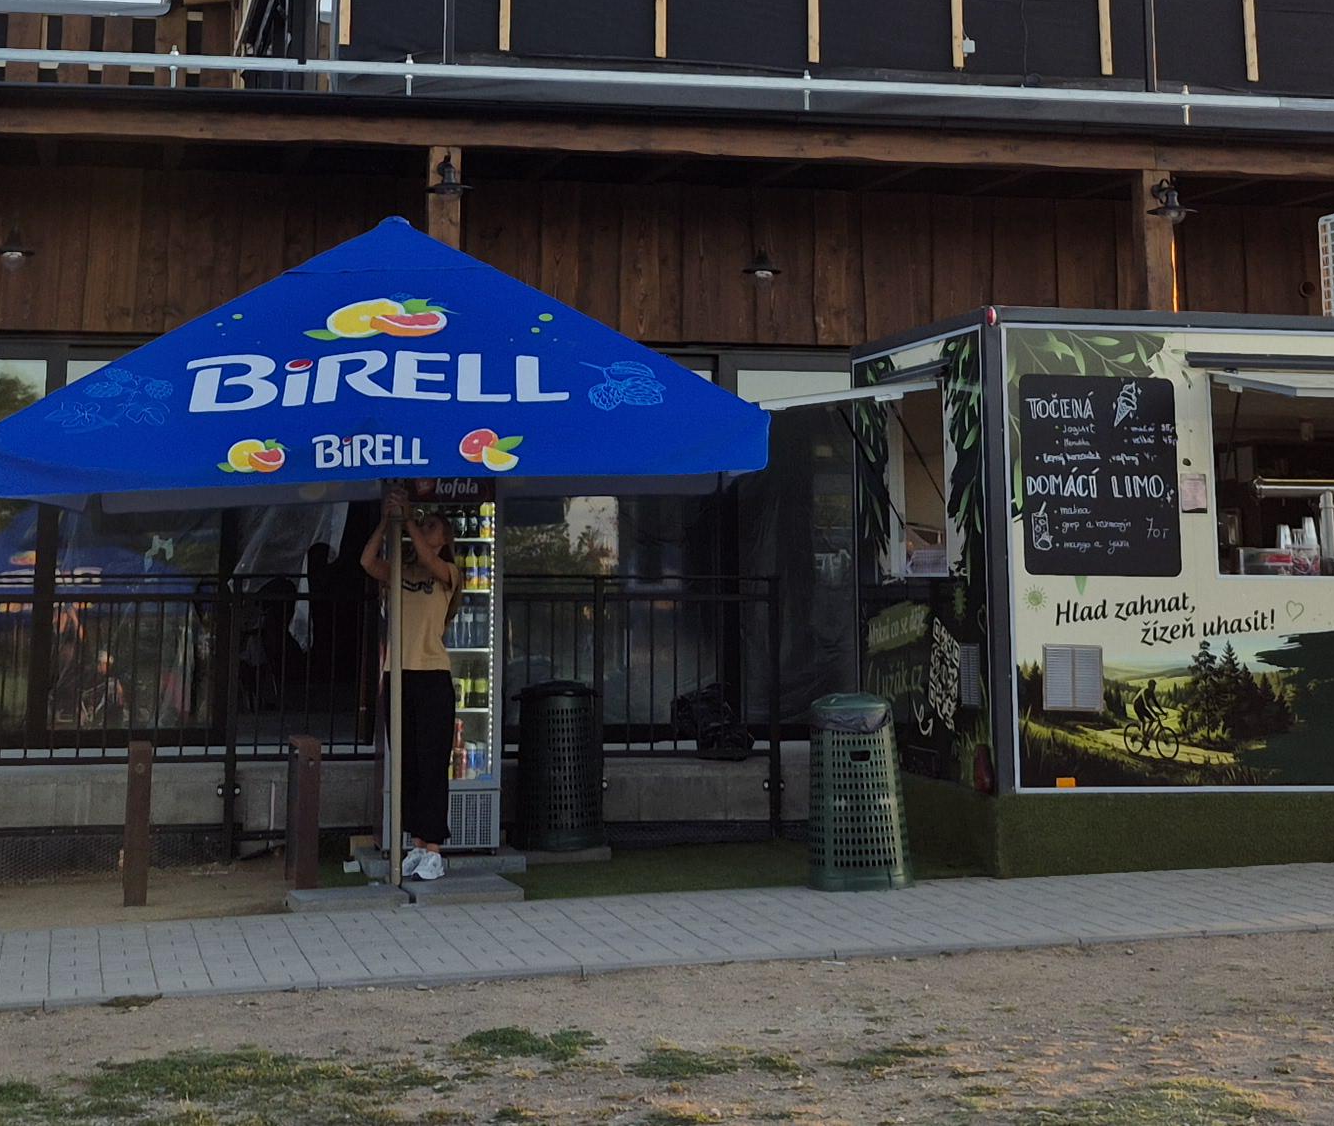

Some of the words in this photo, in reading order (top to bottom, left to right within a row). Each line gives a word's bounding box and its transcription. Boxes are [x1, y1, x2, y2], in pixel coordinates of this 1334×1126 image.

[1025, 391, 1095, 419] TOČENÁ
[435, 478, 479, 499] kofola
[1026, 466, 1100, 499] DOMÁCÍ
[1111, 475, 1165, 499] LIMO
[1055, 599, 1108, 626] Hlad
[1114, 592, 1196, 621] zahnat,
[1140, 616, 1196, 646] žízeň
[1202, 608, 1276, 638] uhasit!
